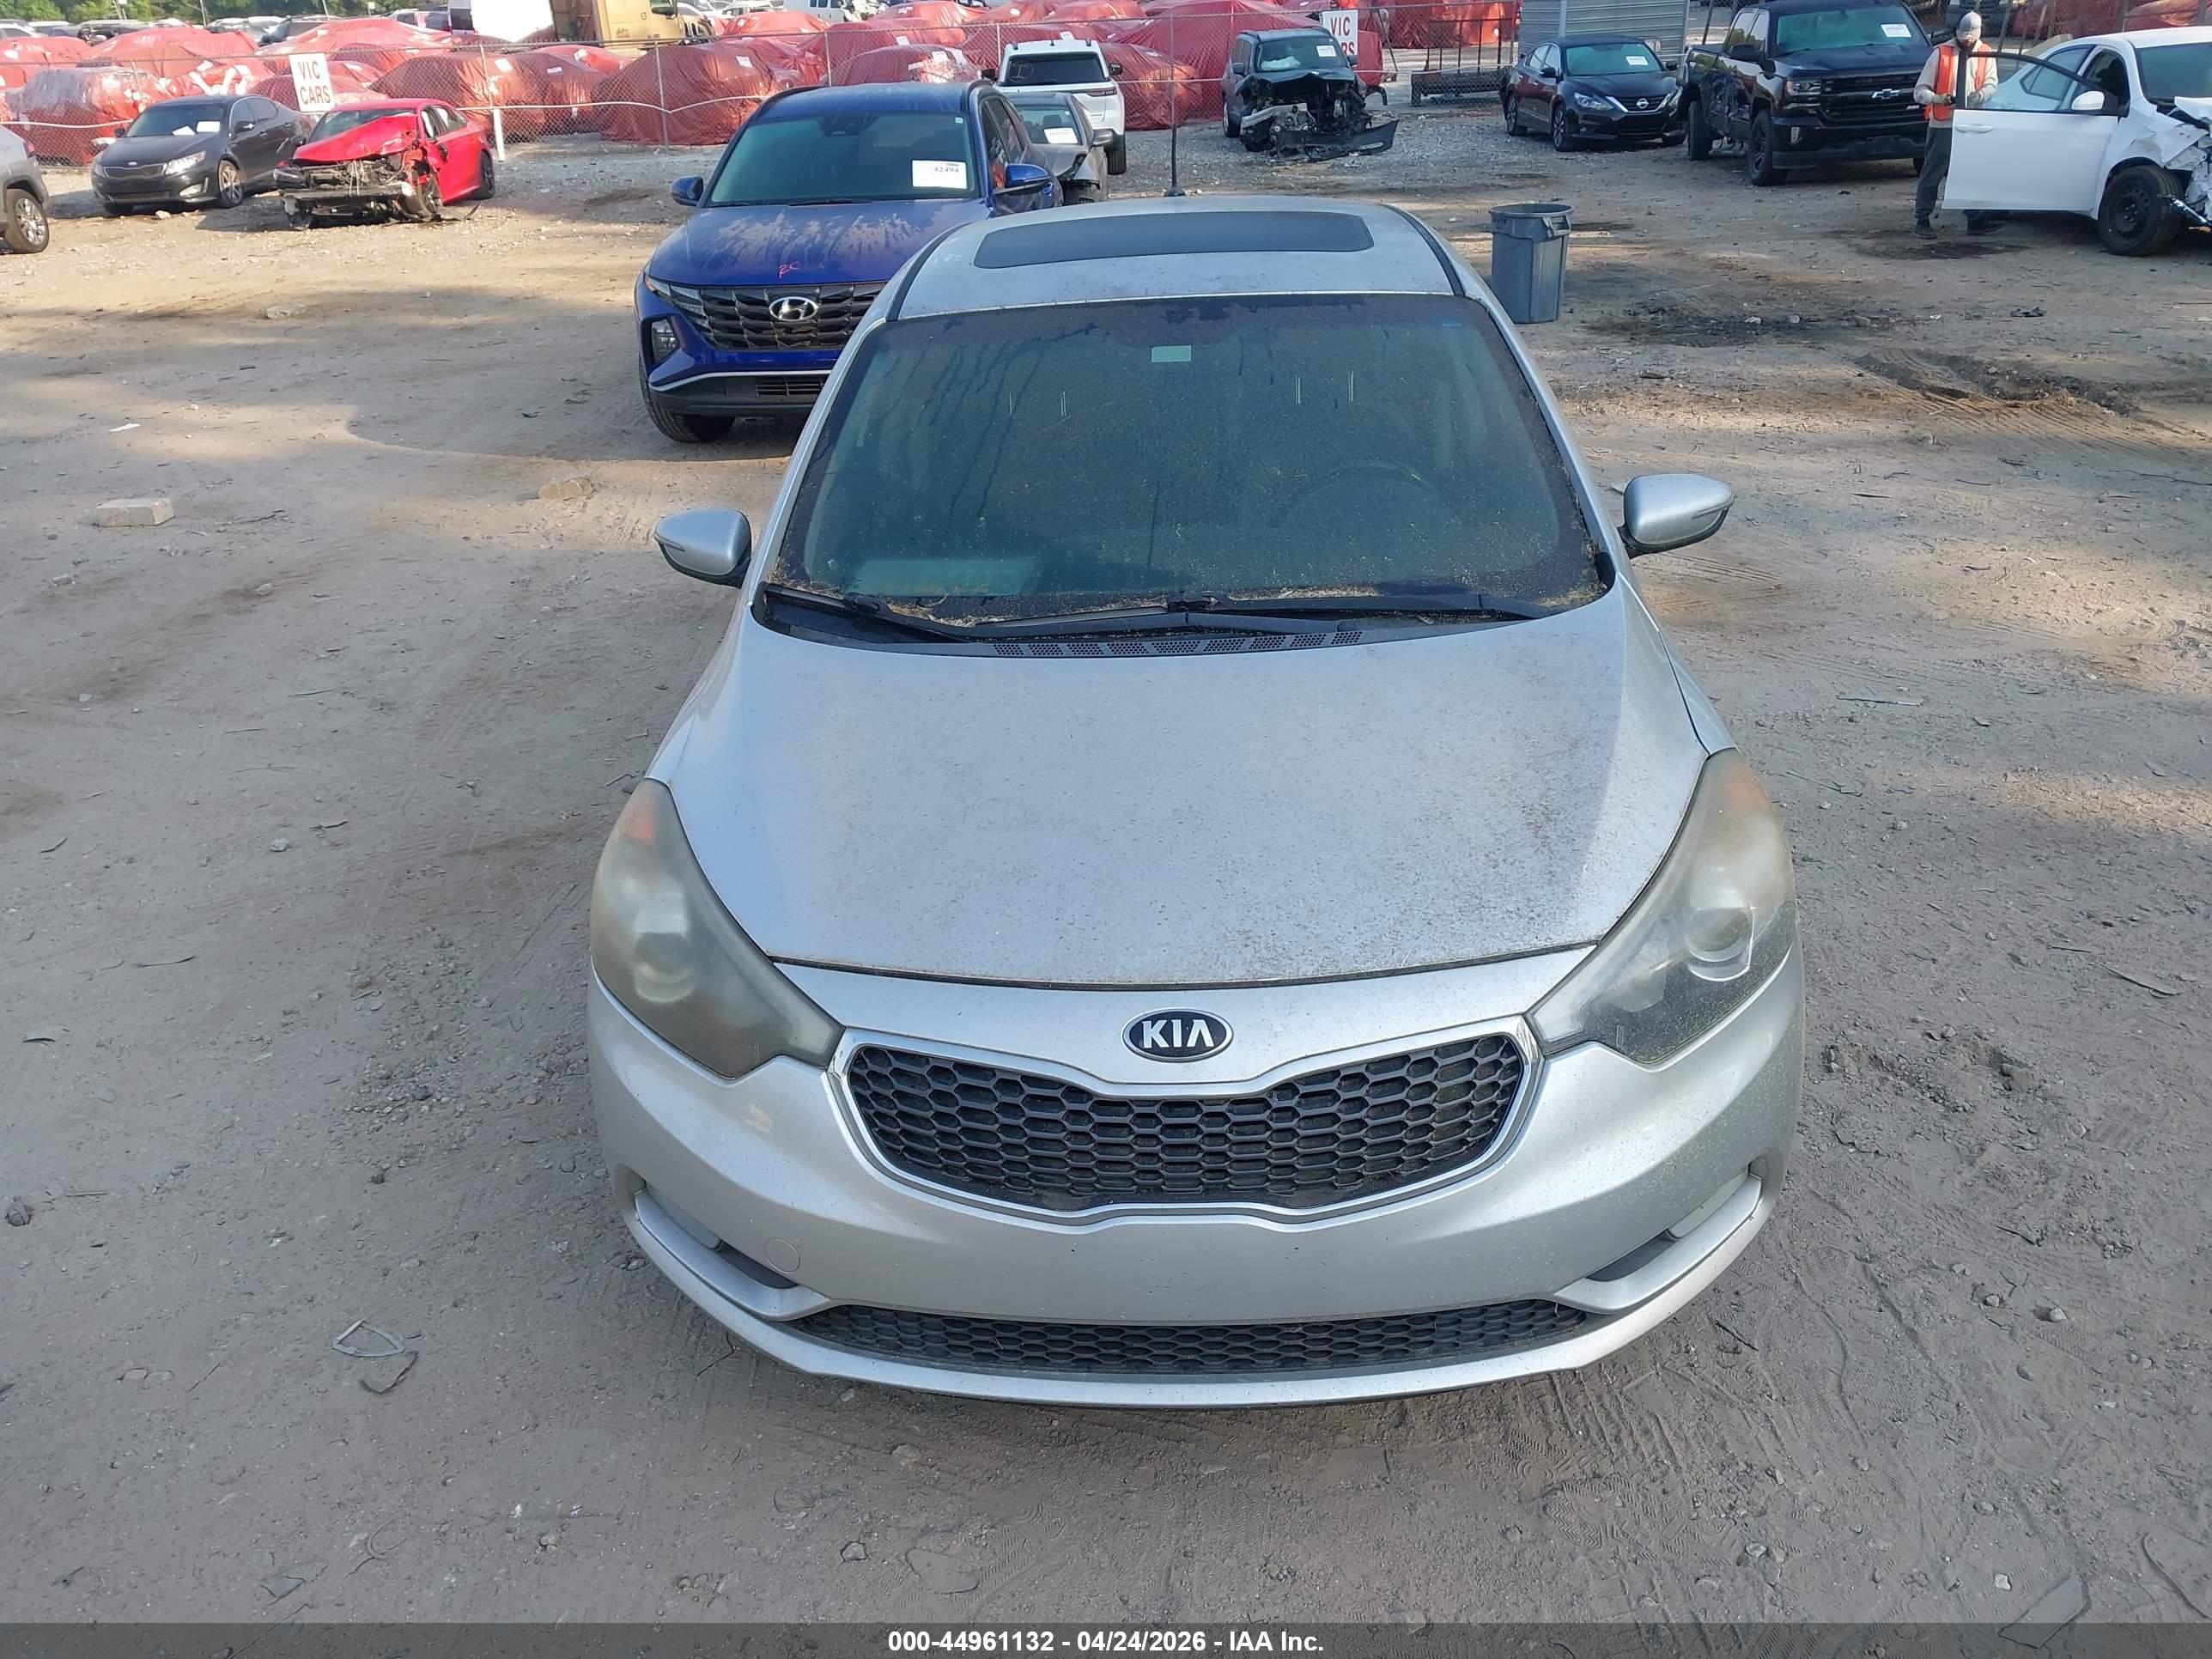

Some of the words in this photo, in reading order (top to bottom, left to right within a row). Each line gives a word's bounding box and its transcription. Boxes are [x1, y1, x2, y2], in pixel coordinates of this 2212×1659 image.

[1330, 16, 1351, 36] VIC
[298, 60, 320, 80] VIC
[300, 85, 331, 105] CARS
[1141, 1018, 1214, 1048] KIA
